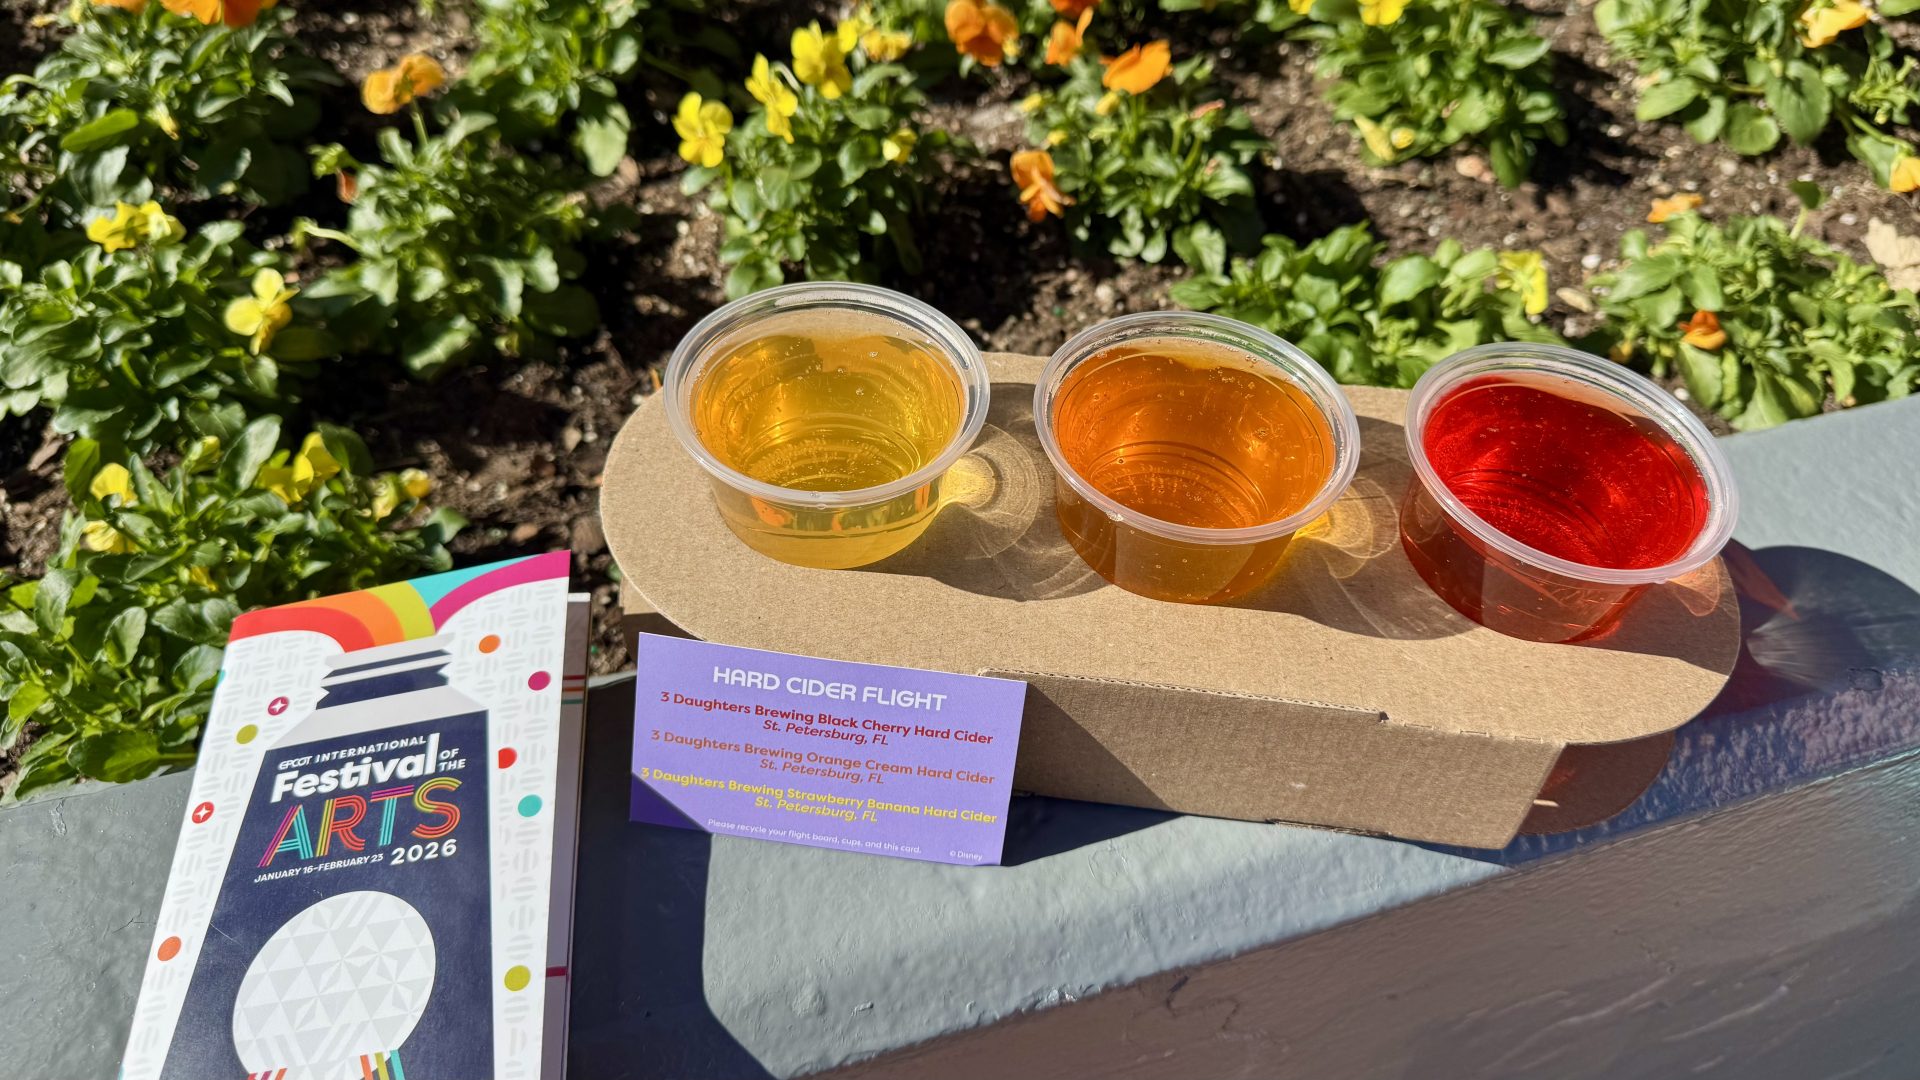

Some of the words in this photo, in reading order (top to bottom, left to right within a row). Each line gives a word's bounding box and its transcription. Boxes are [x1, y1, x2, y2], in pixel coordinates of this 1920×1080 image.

[713, 666, 780, 690] HARD
[786, 676, 857, 701] CIDER
[862, 686, 947, 711] FLIGHT
[660, 691, 670, 702] 3
[674, 694, 750, 714] Daughters
[755, 704, 814, 725] Brewing
[818, 714, 858, 728] Black
[862, 719, 911, 737] Cherry
[914, 725, 950, 740] Hard
[954, 730, 993, 744] Cider
[763, 720, 780, 732] St.
[785, 722, 868, 745] Petersburg,
[872, 734, 888, 746] FL
[270, 732, 440, 804] Festival
[440, 748, 460, 760] OF
[278, 755, 312, 770] EPCOT
[314, 736, 426, 764] INTERNATIONAL
[439, 758, 466, 772] THE
[651, 730, 660, 741] 3
[664, 732, 740, 752] Daughters
[744, 743, 802, 763] Brewing
[807, 752, 862, 770] Orange
[865, 759, 913, 774] Cream
[917, 766, 952, 780] Hard
[956, 770, 996, 784] Cider
[760, 758, 778, 771] St.
[782, 762, 863, 784] Petersburg,
[868, 772, 884, 784] FL
[642, 767, 650, 779] 3
[653, 769, 726, 789] Daughters
[728, 780, 784, 798] Brewing
[787, 788, 864, 809] Strawberry
[867, 798, 920, 814] Banana
[924, 805, 958, 820] Hard
[960, 809, 998, 824] Cider
[755, 797, 772, 808] St.
[777, 800, 858, 822] Petersburg,
[862, 811, 878, 822] FL
[257, 776, 463, 868] ARTS
[708, 818, 735, 830] Please
[738, 822, 766, 834] recycle
[768, 828, 786, 837] your
[788, 828, 811, 841] flight
[812, 833, 840, 845] board,
[865, 840, 882, 849] and
[884, 842, 899, 850] this
[901, 844, 922, 854] card.
[254, 868, 301, 883] JANUARY
[370, 853, 384, 863] 23
[390, 838, 458, 866] 2026
[958, 850, 982, 862] Disney
